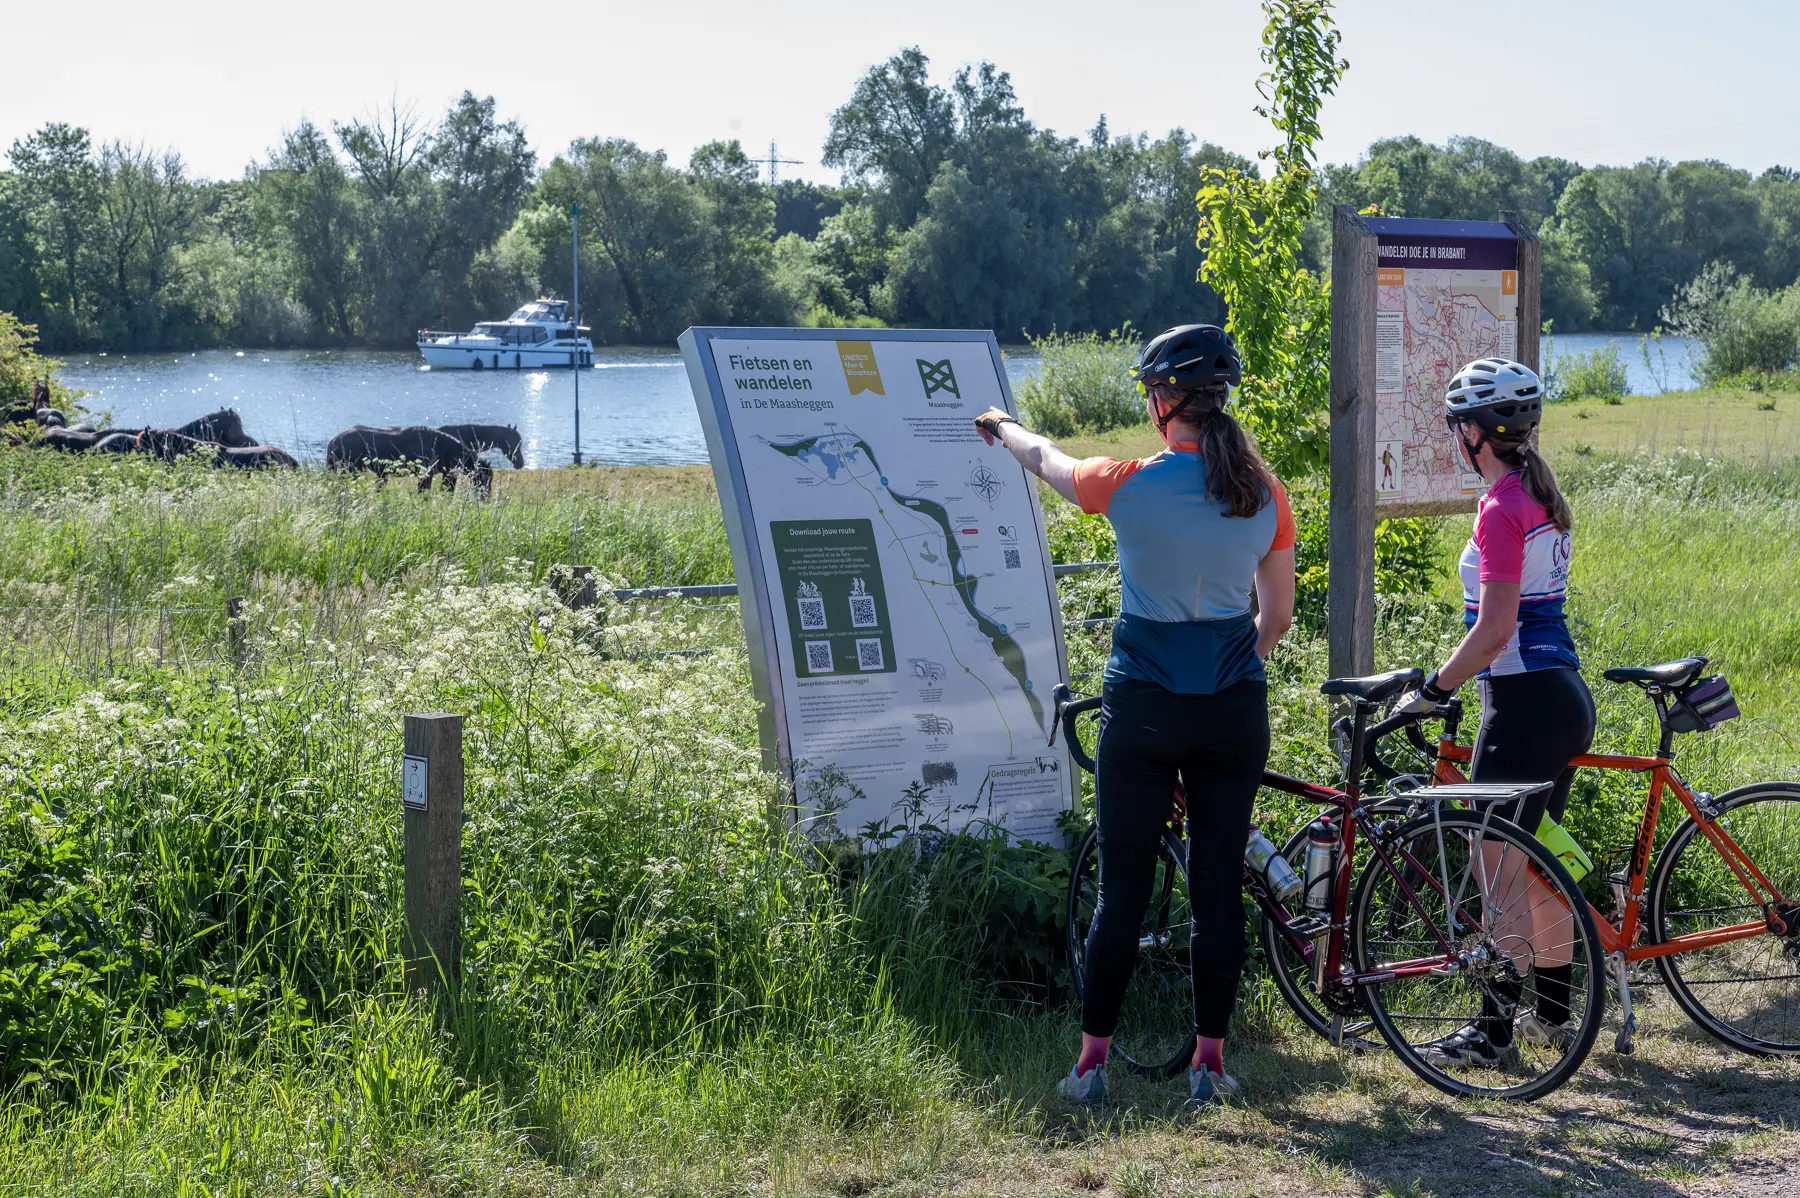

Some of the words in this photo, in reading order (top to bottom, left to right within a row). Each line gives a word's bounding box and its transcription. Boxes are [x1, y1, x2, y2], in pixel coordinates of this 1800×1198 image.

[1409, 246, 1422, 258] DOE
[1422, 246, 1428, 258] JE
[1430, 247, 1436, 258] IN
[1438, 247, 1466, 259] BRABANT!
[728, 355, 790, 370] Fietsen
[794, 359, 812, 370] en
[734, 375, 812, 390] wandelen
[740, 398, 752, 408] in
[754, 399, 768, 408] De
[771, 398, 834, 411] Maasheggen
[822, 528, 838, 536] jouw
[991, 767, 1036, 778] Gedragsregels
[1635, 794, 1656, 876] Gazelle
